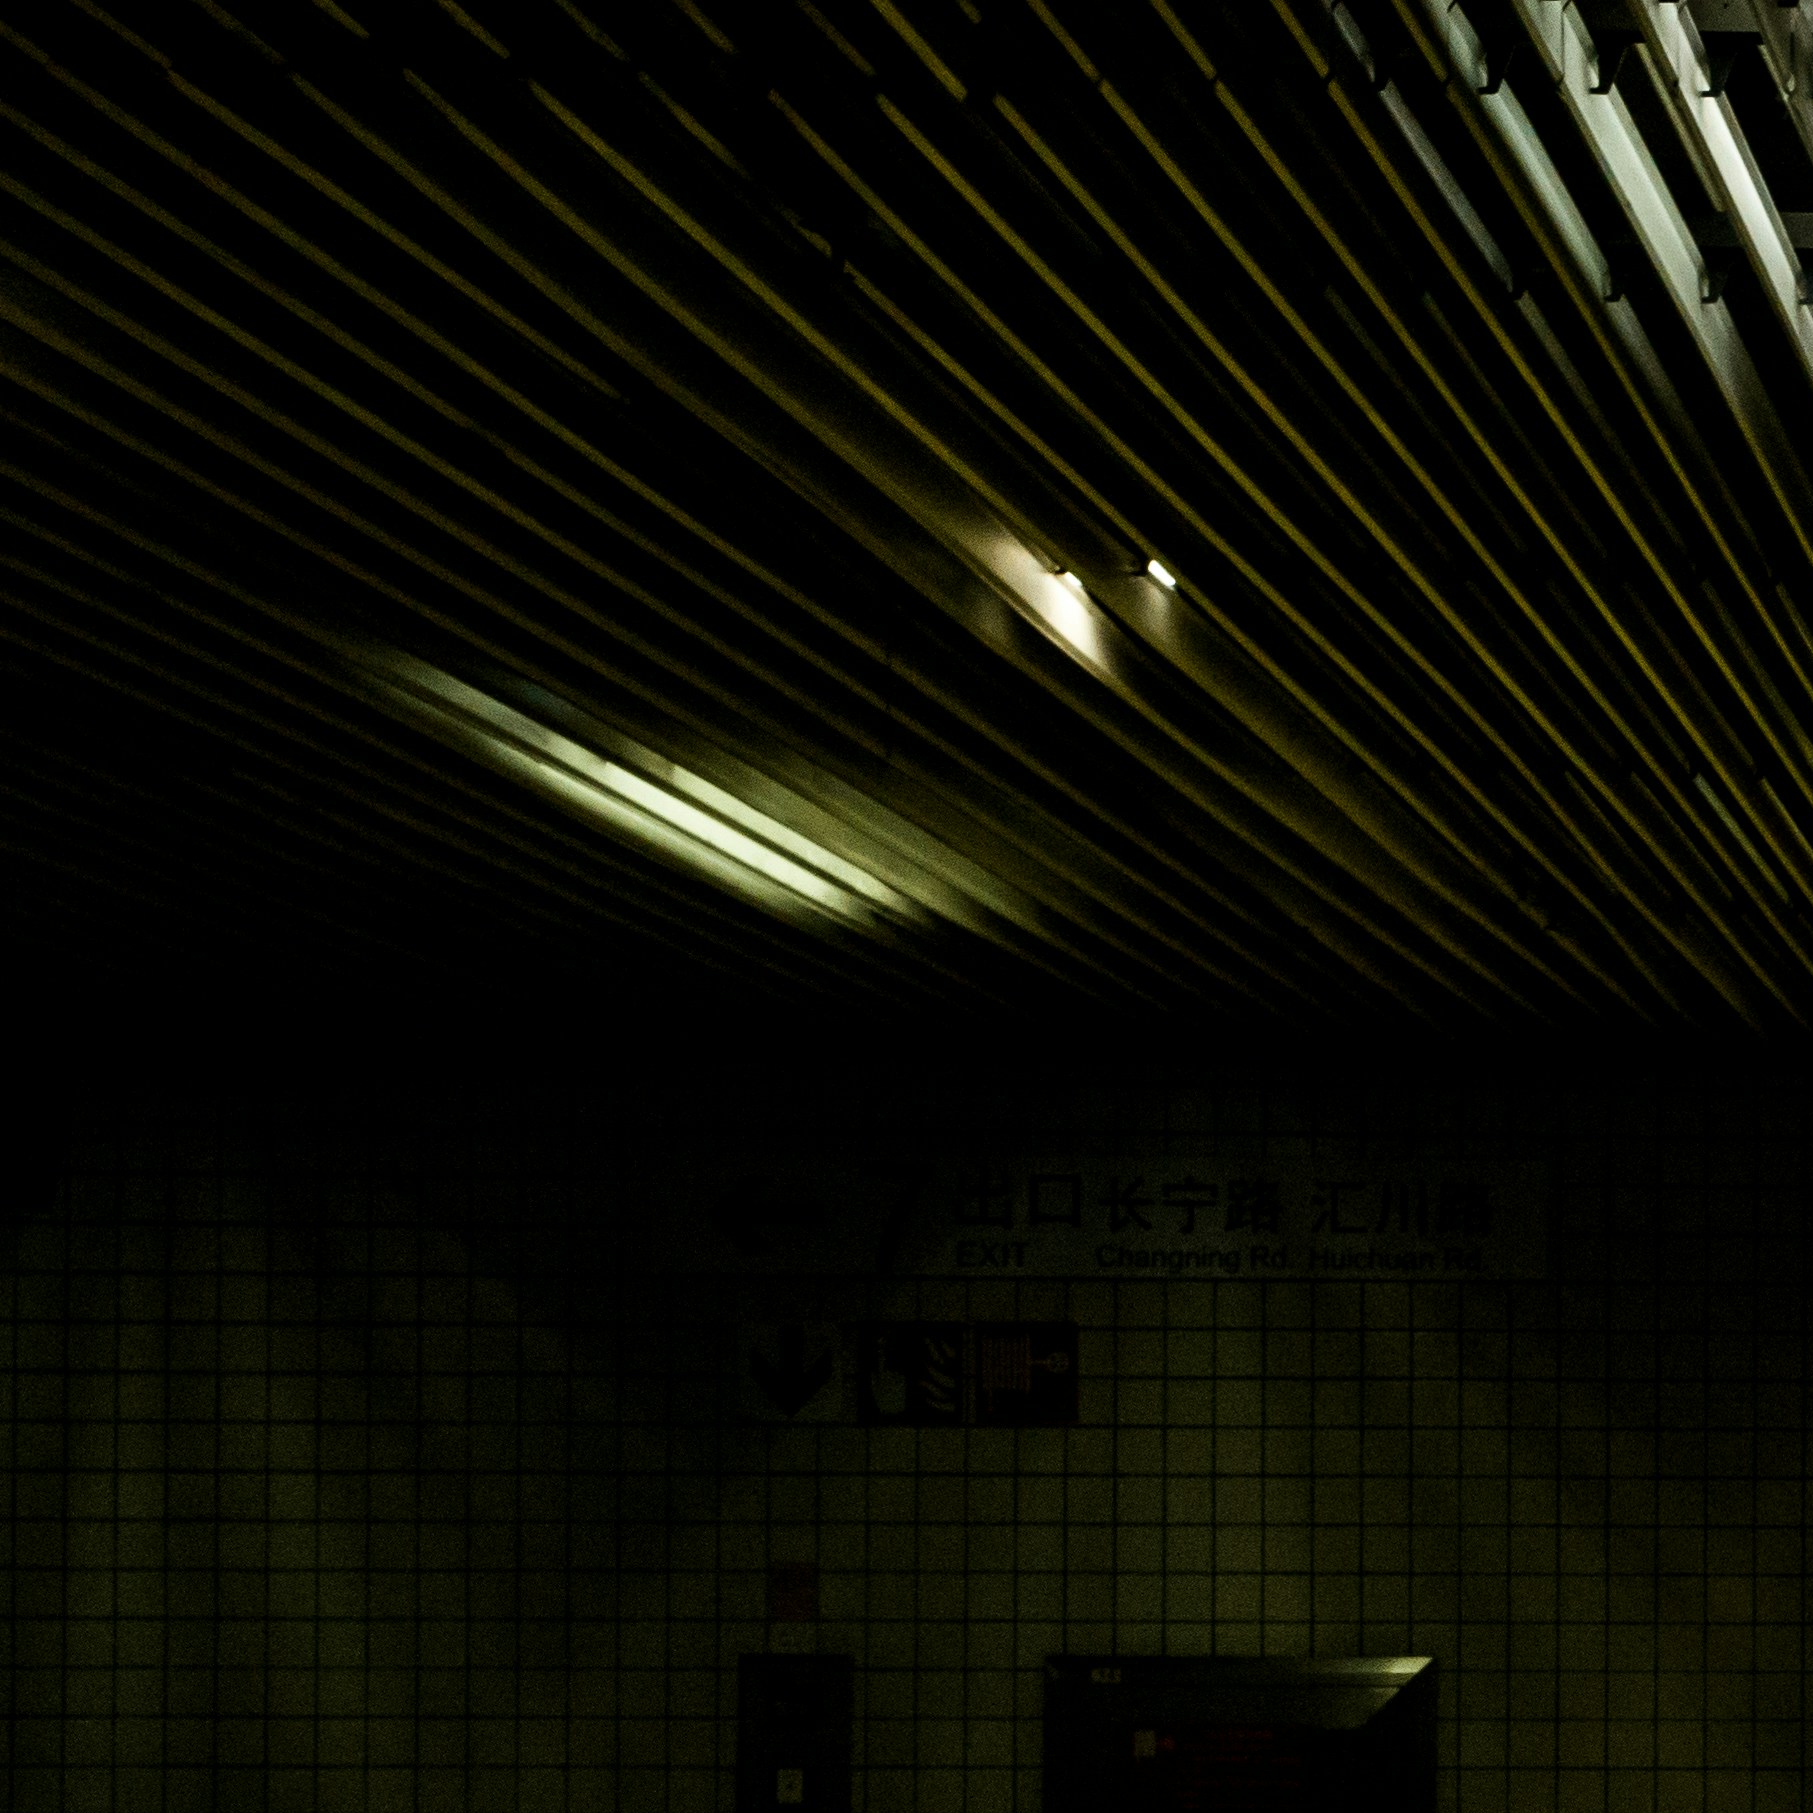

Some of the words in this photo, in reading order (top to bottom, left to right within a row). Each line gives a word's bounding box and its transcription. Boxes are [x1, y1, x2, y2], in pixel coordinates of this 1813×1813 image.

[953, 1164, 1080, 1230] 出口
[1097, 1176, 1283, 1233] 长宁路
[1311, 1177, 1493, 1235] 汇川路
[956, 1241, 1028, 1267] EXIT
[1096, 1244, 1239, 1272] Changning
[1308, 1247, 1434, 1270] Huichuan
